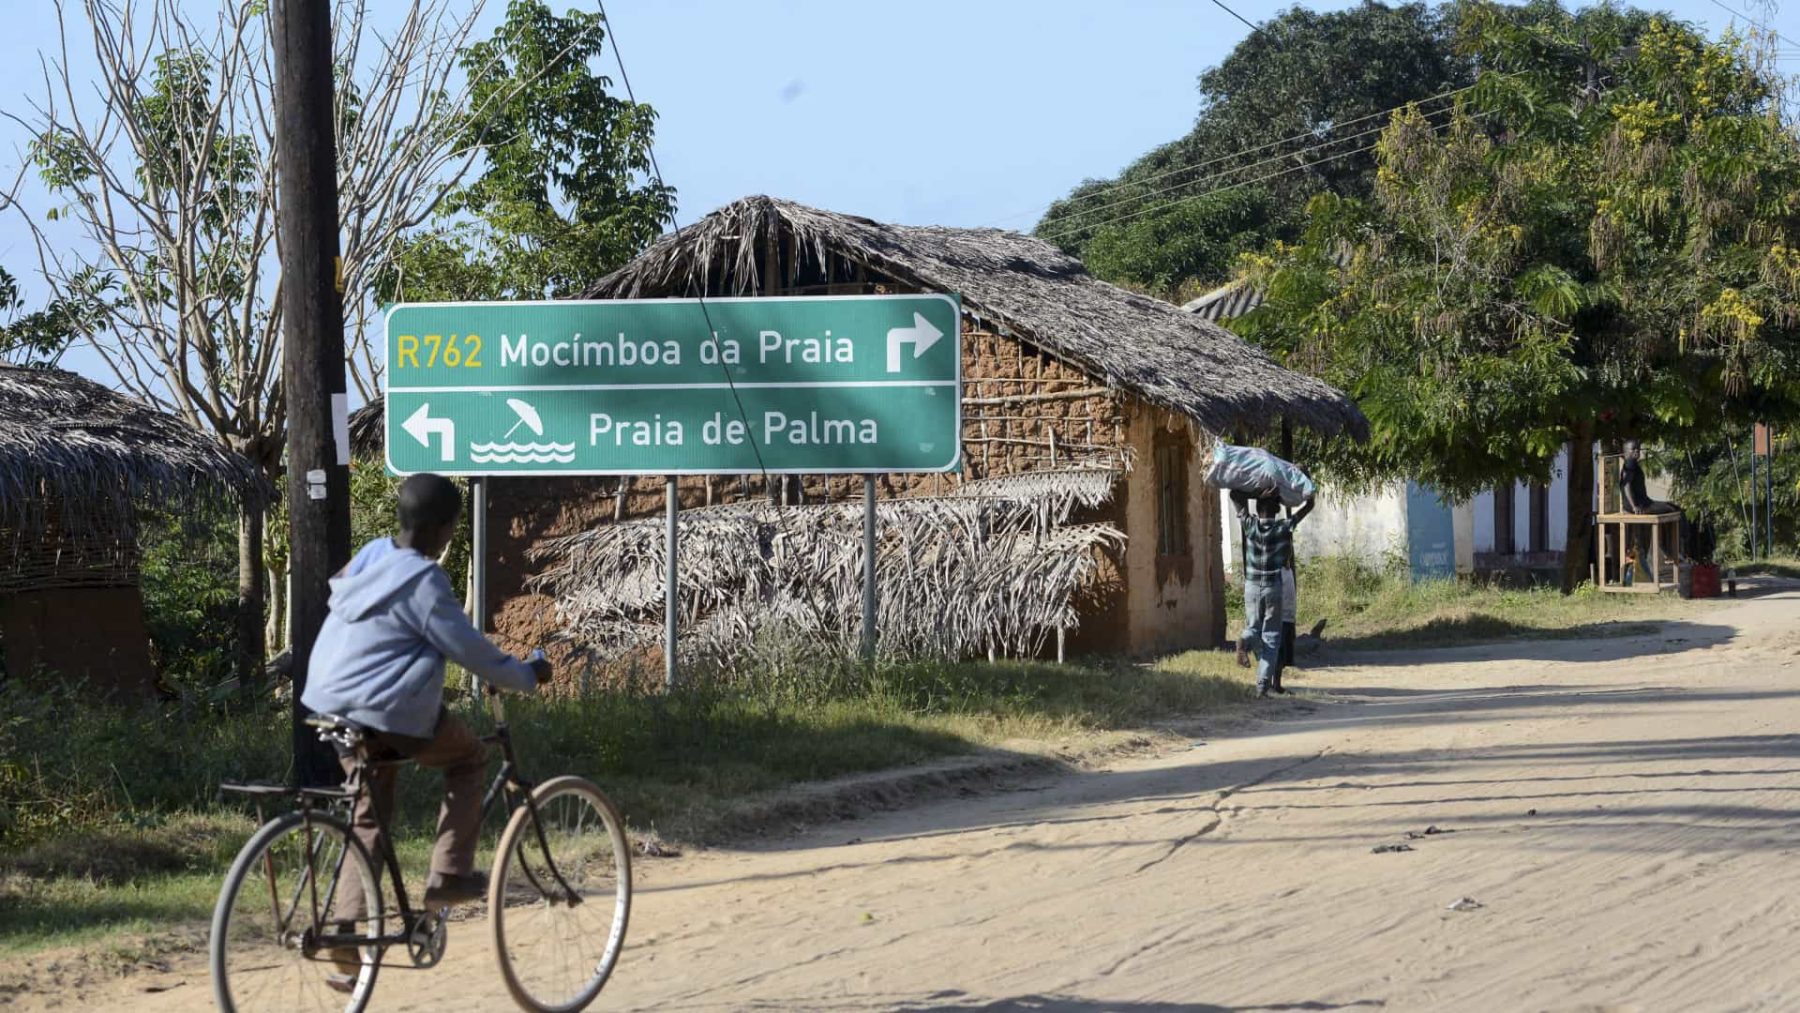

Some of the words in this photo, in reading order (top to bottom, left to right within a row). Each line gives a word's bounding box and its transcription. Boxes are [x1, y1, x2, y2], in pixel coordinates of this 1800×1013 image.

[397, 334, 482, 369] R762
[500, 332, 681, 367] Mocímboa
[700, 331, 740, 364] da
[759, 330, 854, 363] Praia
[589, 412, 684, 447] Praia
[702, 411, 745, 445] de
[764, 411, 877, 445] Palma
